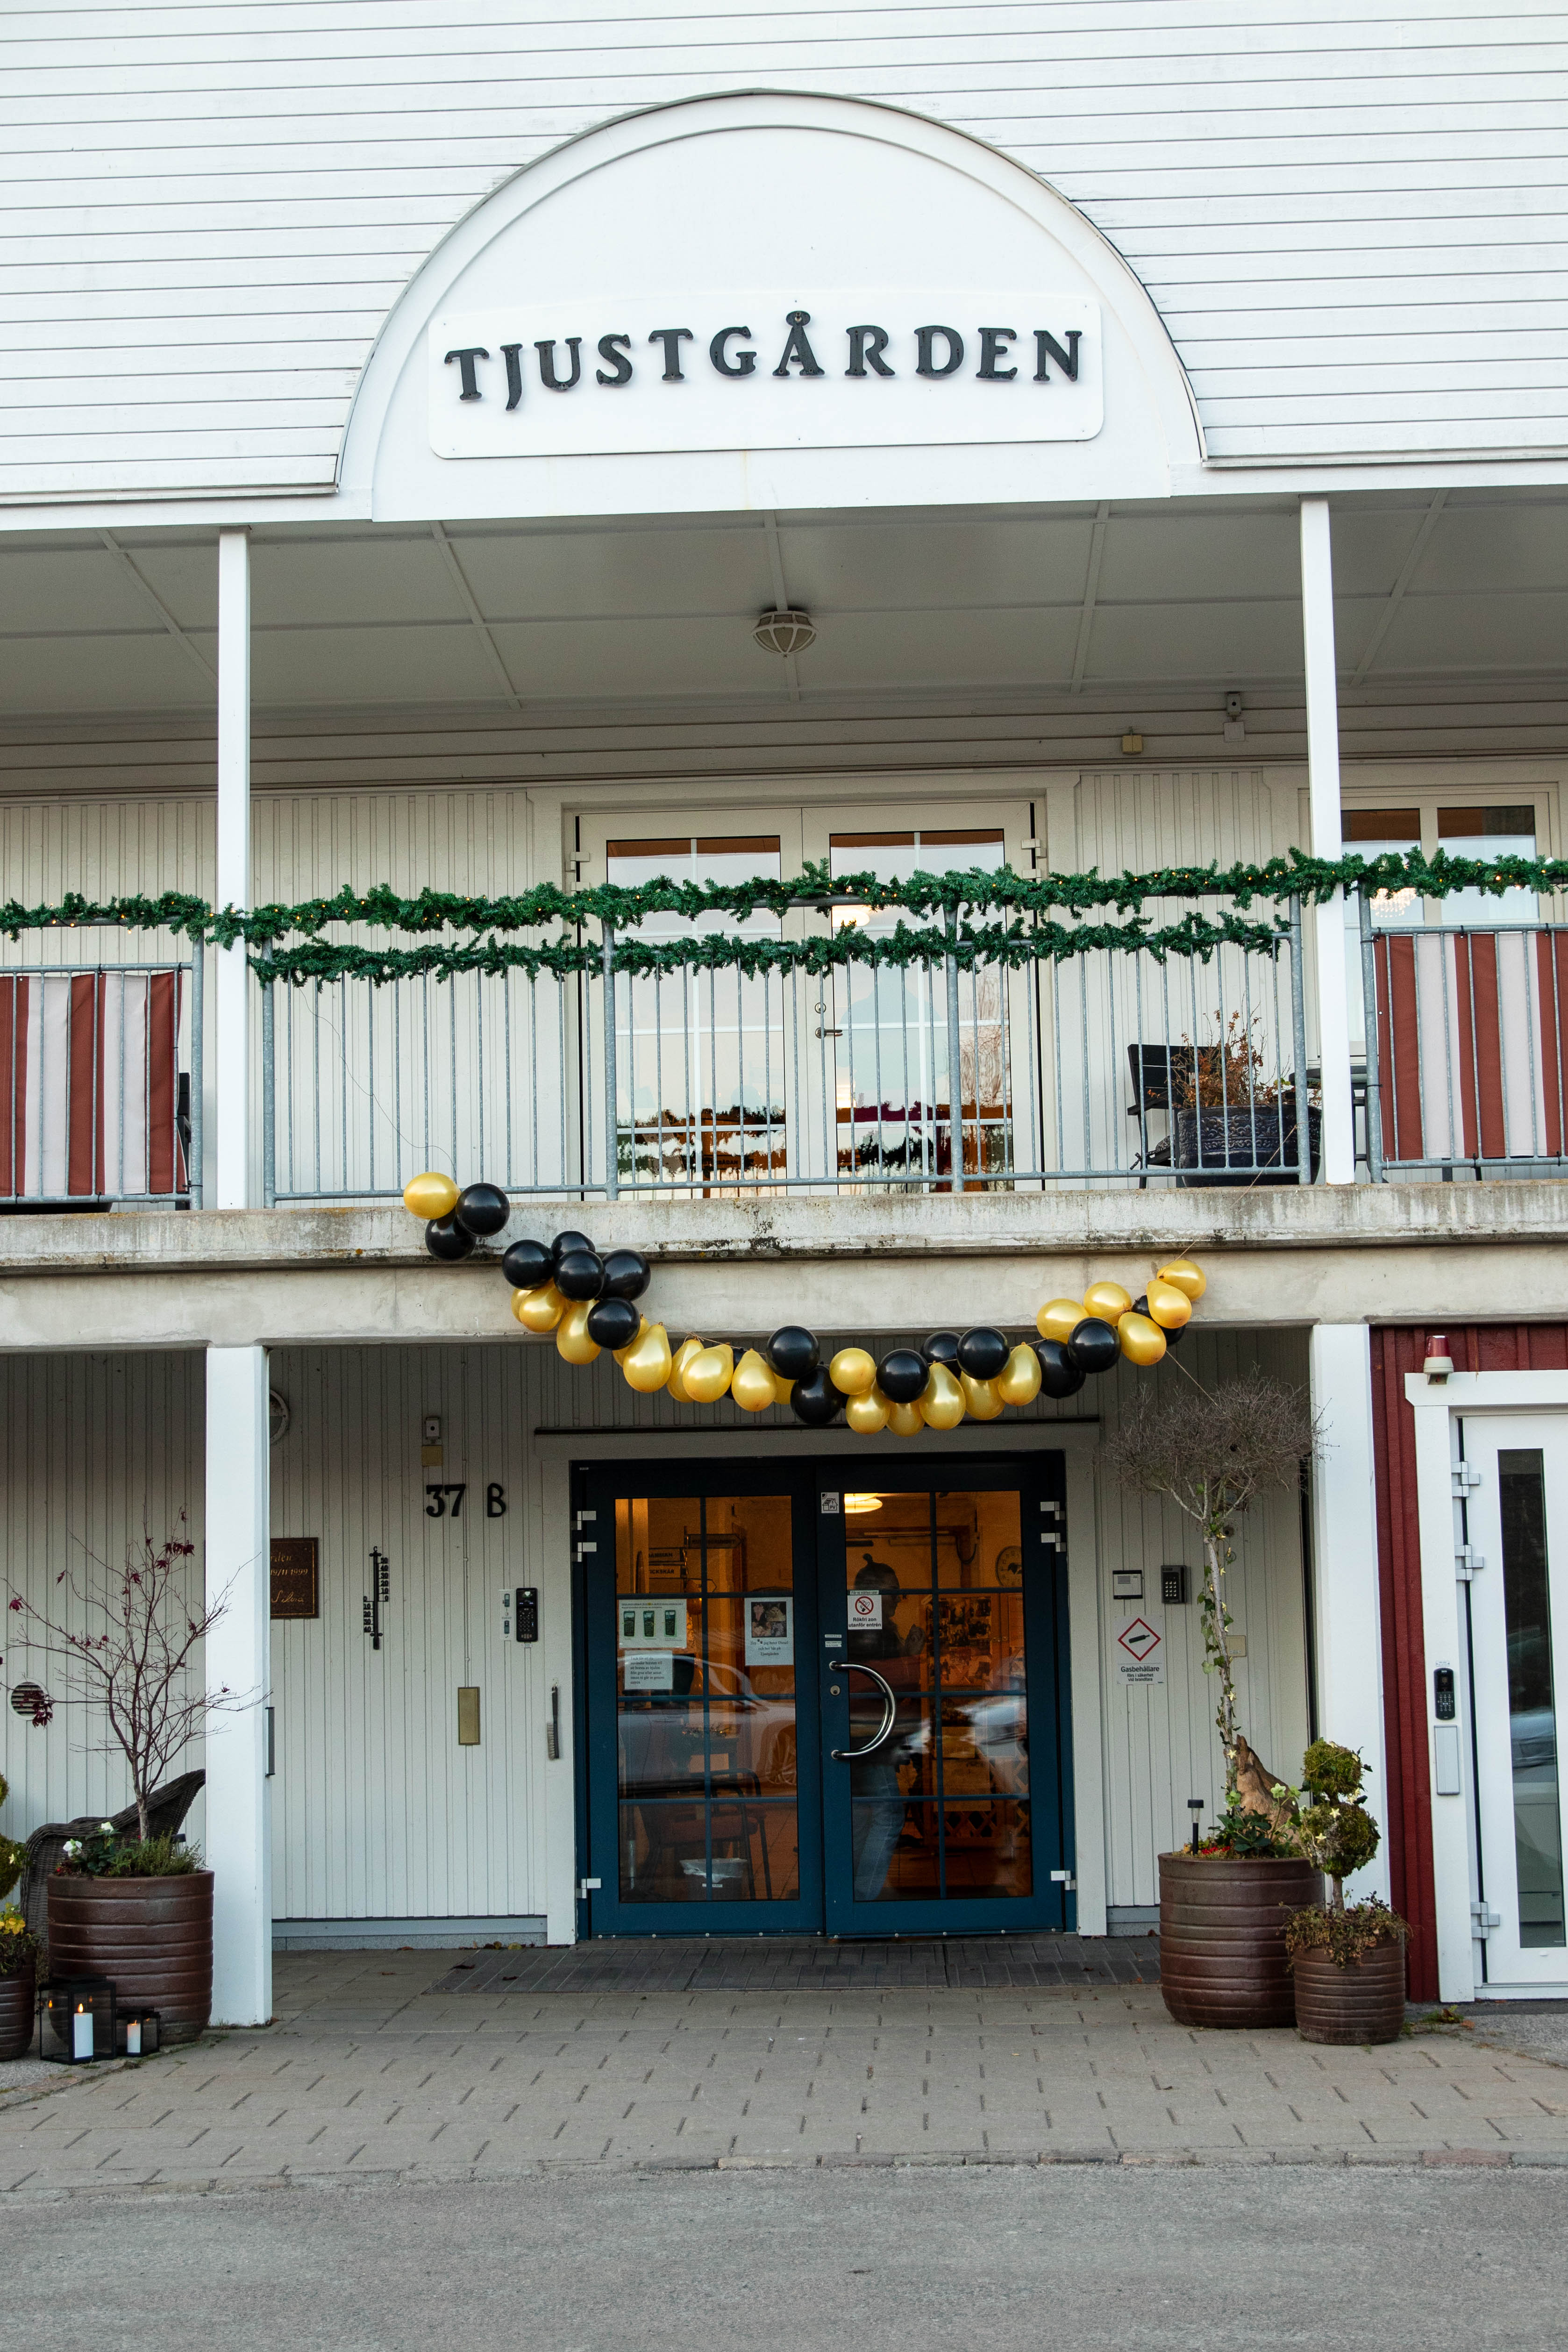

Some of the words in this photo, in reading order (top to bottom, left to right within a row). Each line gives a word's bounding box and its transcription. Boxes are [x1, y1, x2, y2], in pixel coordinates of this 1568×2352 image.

[444, 310, 1083, 412] TJUSTGÅRDEN
[426, 1483, 466, 1518] 37
[487, 1482, 506, 1518] B
[271, 1552, 292, 1562] rden
